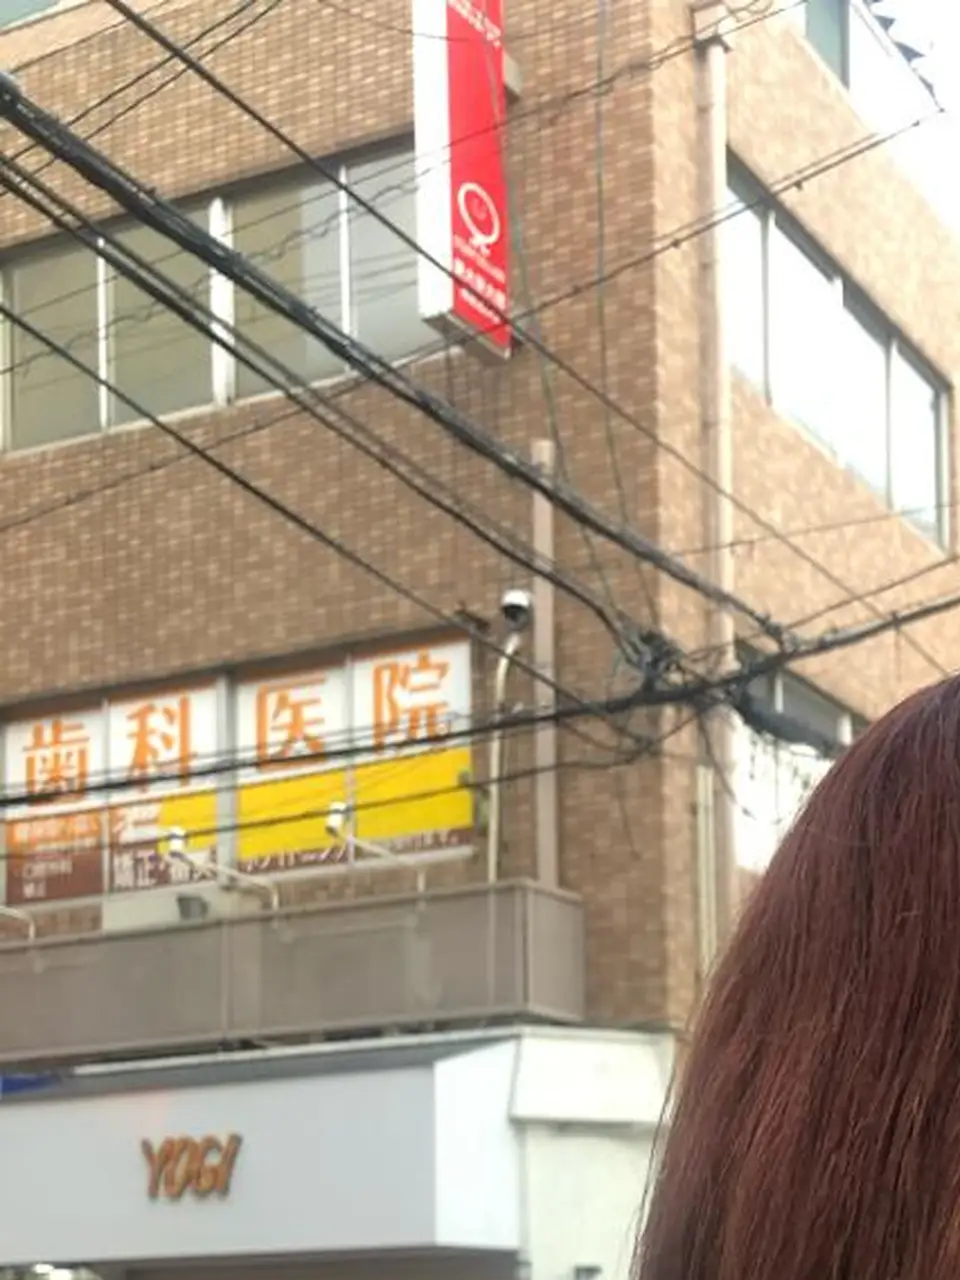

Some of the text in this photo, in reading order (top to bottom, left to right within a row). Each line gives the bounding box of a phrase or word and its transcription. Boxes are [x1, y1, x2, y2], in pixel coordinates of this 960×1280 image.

[24, 651, 449, 805] 歯科医院
[141, 1133, 242, 1200] YOGI
